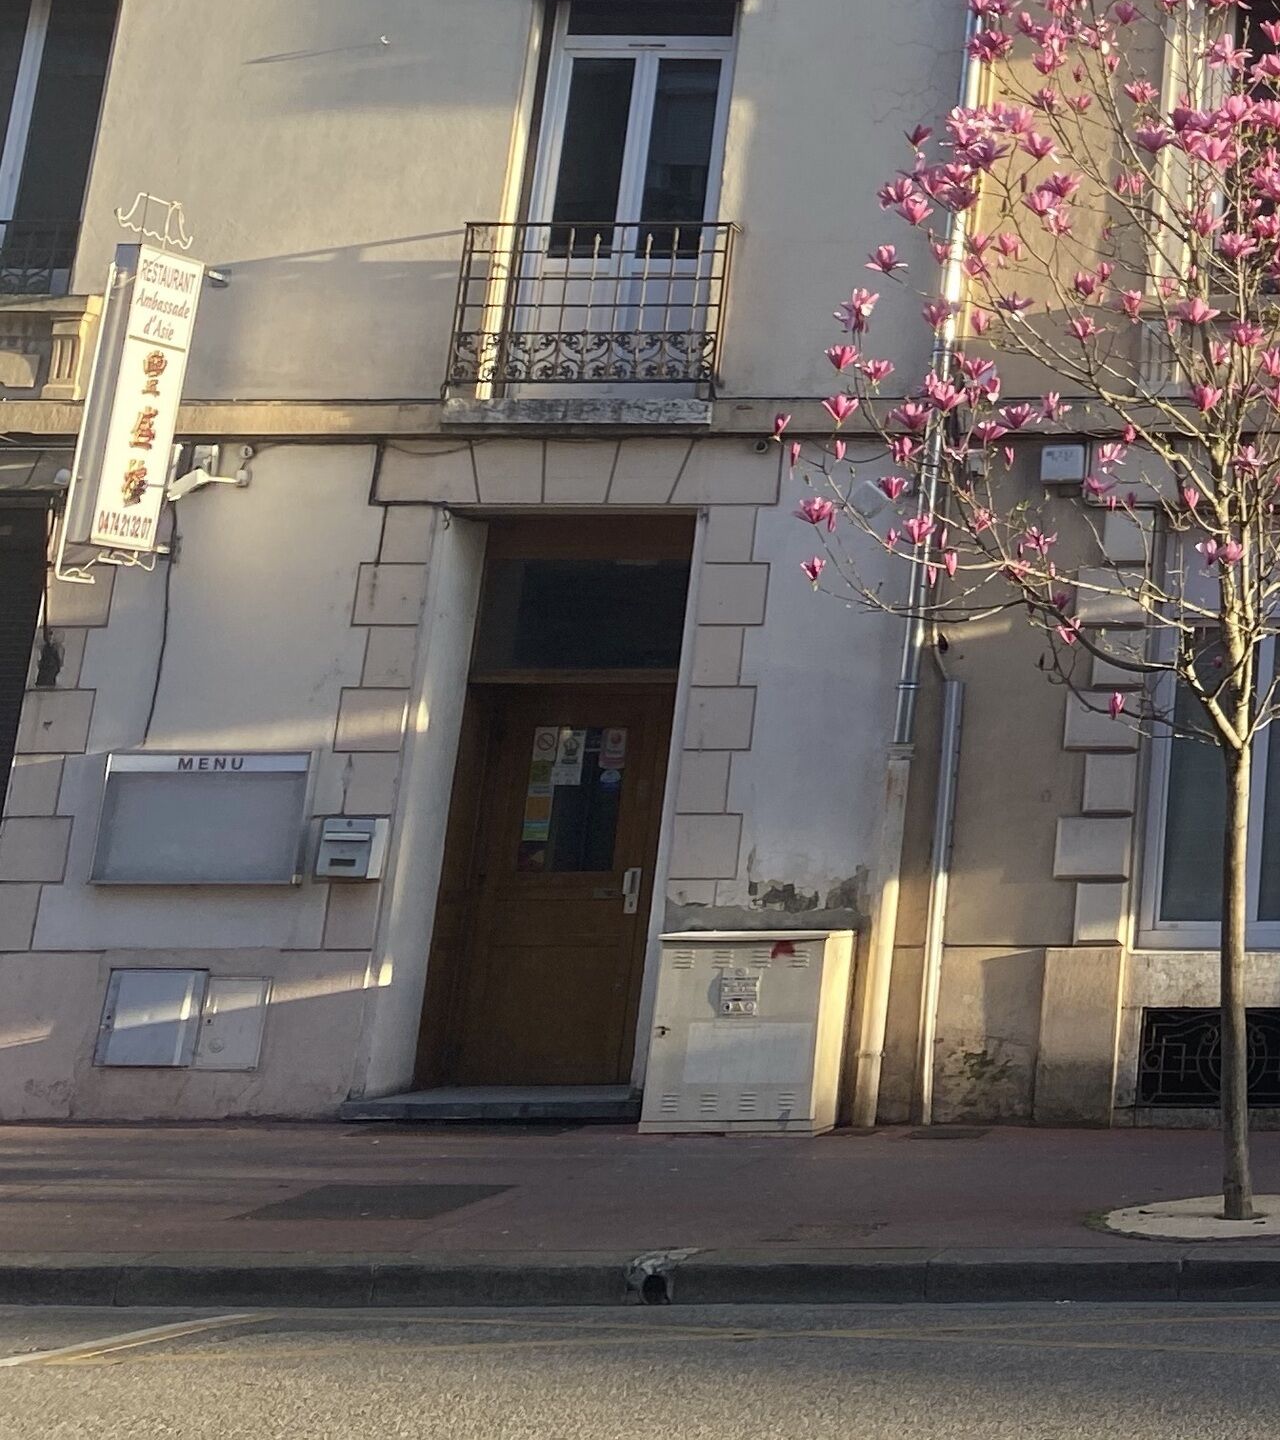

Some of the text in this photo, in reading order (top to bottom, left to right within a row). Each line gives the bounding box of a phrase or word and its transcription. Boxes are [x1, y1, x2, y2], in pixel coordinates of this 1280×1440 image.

[141, 259, 196, 294] RESTAURANT
[135, 288, 190, 319] Ambassade
[142, 315, 175, 341] d'Asie
[99, 510, 110, 533] 04
[177, 757, 244, 770] MENU
